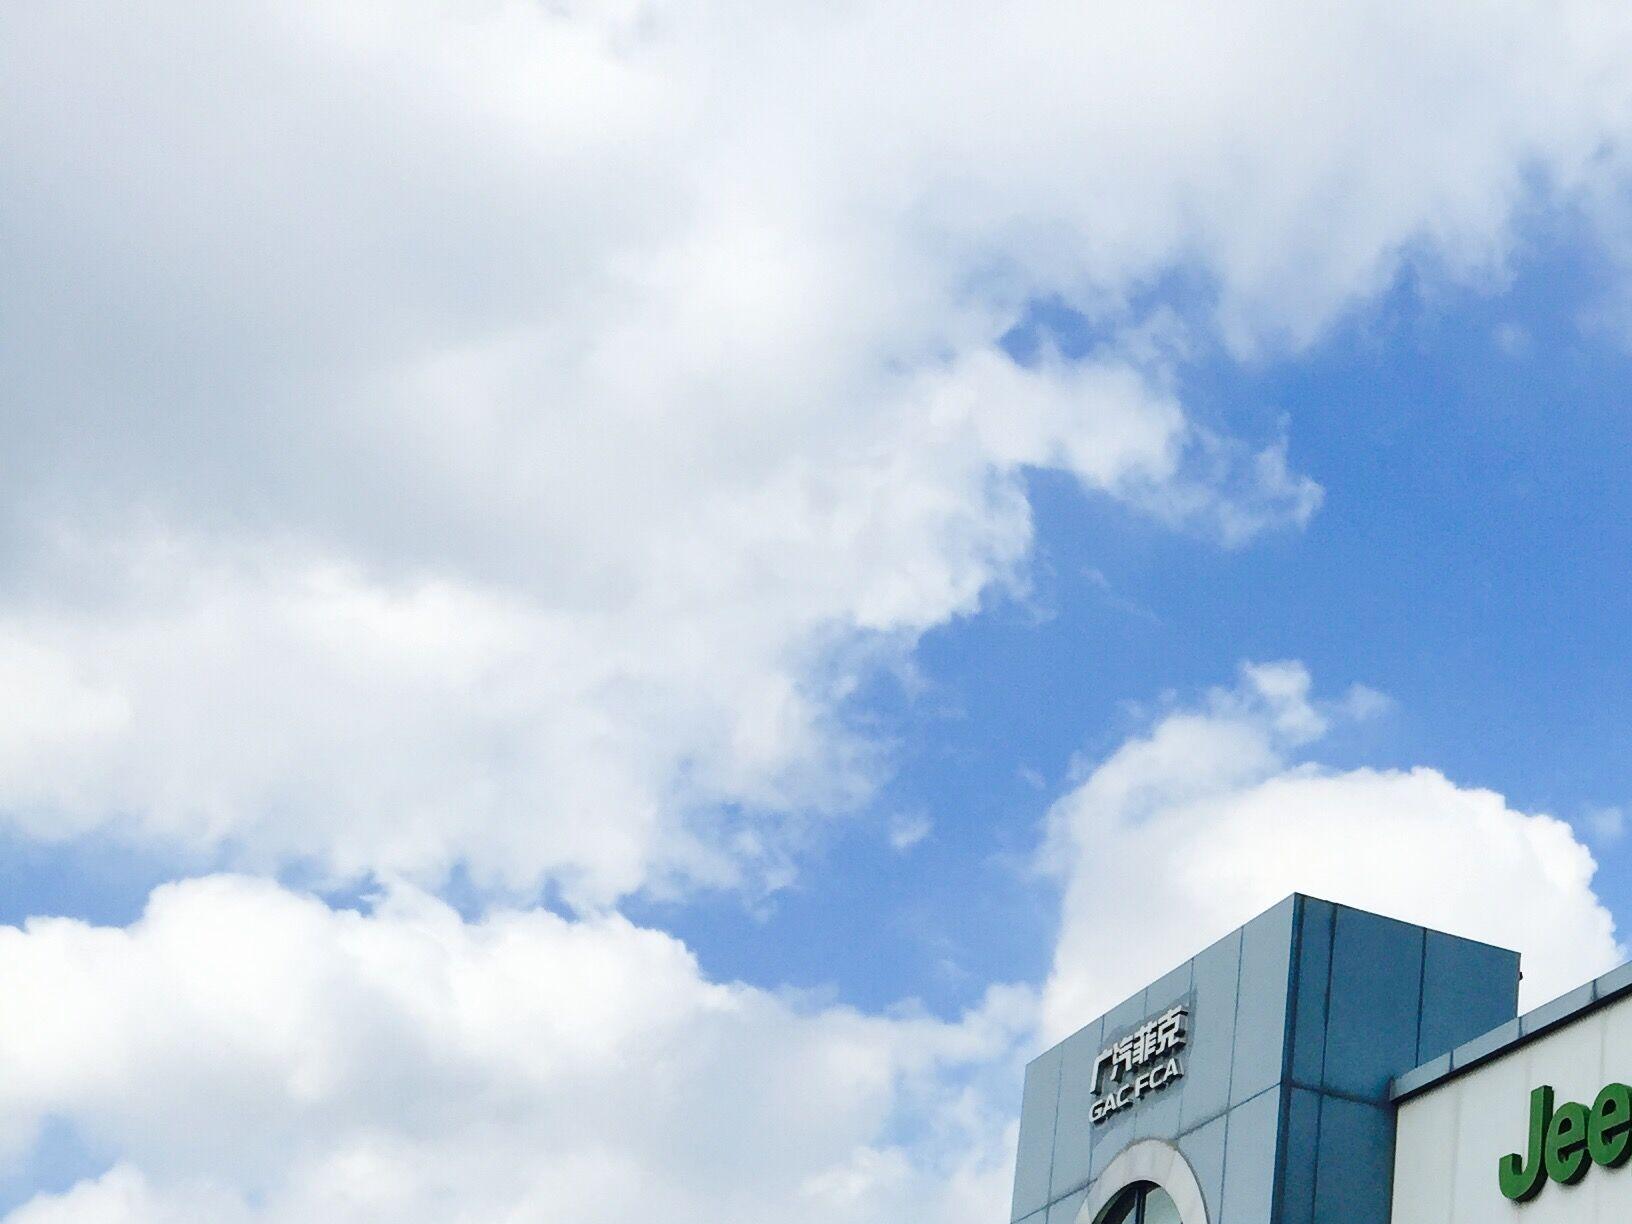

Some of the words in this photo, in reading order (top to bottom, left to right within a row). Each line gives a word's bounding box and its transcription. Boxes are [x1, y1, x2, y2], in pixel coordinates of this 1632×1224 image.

[1090, 1005, 1186, 1093] 广汽菲克
[1089, 1083, 1132, 1123] GAC
[1135, 1058, 1183, 1099] FCA
